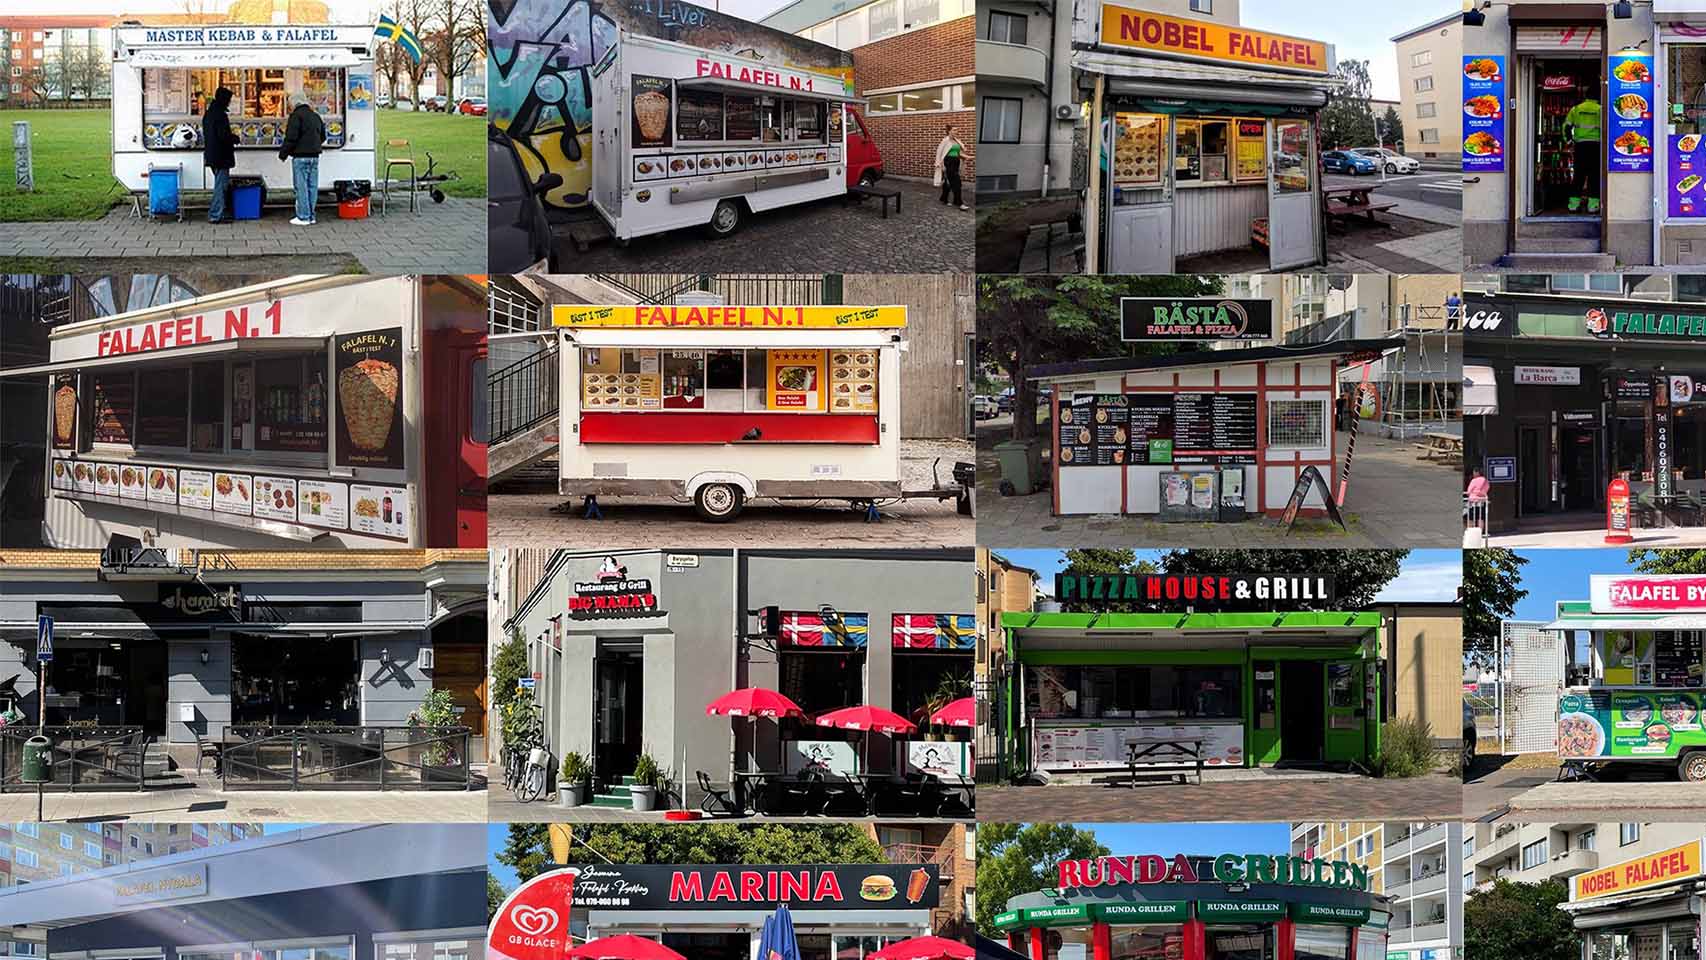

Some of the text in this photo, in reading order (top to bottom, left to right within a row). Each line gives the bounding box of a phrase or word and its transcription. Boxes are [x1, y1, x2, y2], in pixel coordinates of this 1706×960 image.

[146, 30, 339, 42] MASTER KEBAB & FALAFEL
[1120, 14, 1317, 66] NOBEL FALAFEL
[696, 57, 785, 86] FALAFEL
[634, 306, 752, 326] FALAFEL
[1154, 302, 1232, 325] BÄSTA
[98, 314, 212, 357] FALAFEL
[1147, 324, 1238, 335] FALAFEL PIZZA
[341, 334, 377, 352] FALAFEL
[575, 580, 647, 593] Restaurang Grill
[1062, 576, 1231, 600] PIZZA HOUSE
[1610, 585, 1680, 601] FALAFEL
[569, 594, 593, 609] BIG
[1057, 852, 1368, 892] RUNDA GRILLEN
[1582, 851, 1690, 895] NOBEL FALAFEL
[669, 871, 844, 902] MARINA
[1030, 907, 1080, 919] RUNDA GRILLEN
[1105, 904, 1176, 914] RUNDA GRILLEN
[1207, 903, 1280, 911] RUNDA GRILLEN
[1310, 906, 1364, 917] RUNDA GRILLEN
[509, 934, 557, 948] GB GLACE
